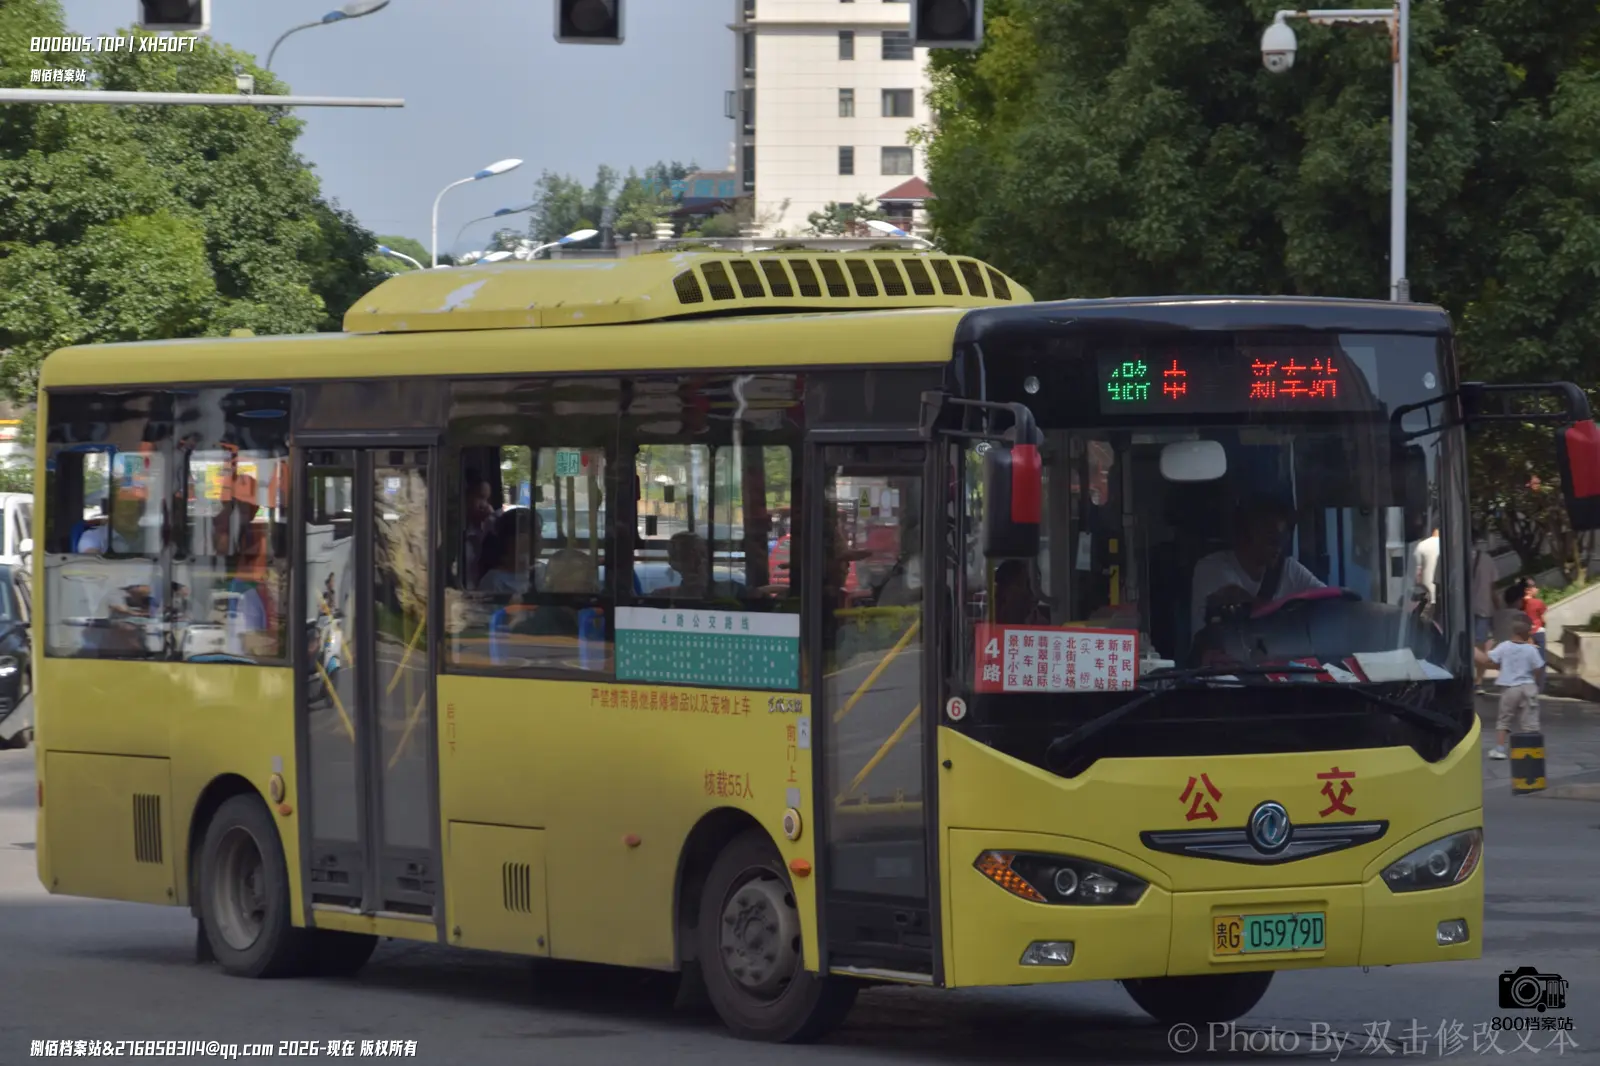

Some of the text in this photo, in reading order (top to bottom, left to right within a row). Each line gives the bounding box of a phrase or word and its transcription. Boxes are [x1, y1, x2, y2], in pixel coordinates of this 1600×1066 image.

[983, 637, 1001, 682] 4路
[1007, 635, 1020, 687] 景宁小区
[1022, 634, 1034, 687] 新车站
[1037, 636, 1049, 687] 翡翠国际
[1064, 637, 1077, 689] 北街菜场
[1094, 639, 1106, 690] 老车站
[1107, 639, 1119, 690] 新中医院
[591, 687, 752, 718] 严禁携带易燃易爆物品以及宠物上车
[951, 700, 962, 717] 6
[786, 724, 798, 783] 前门上
[704, 768, 754, 800] 核载55人
